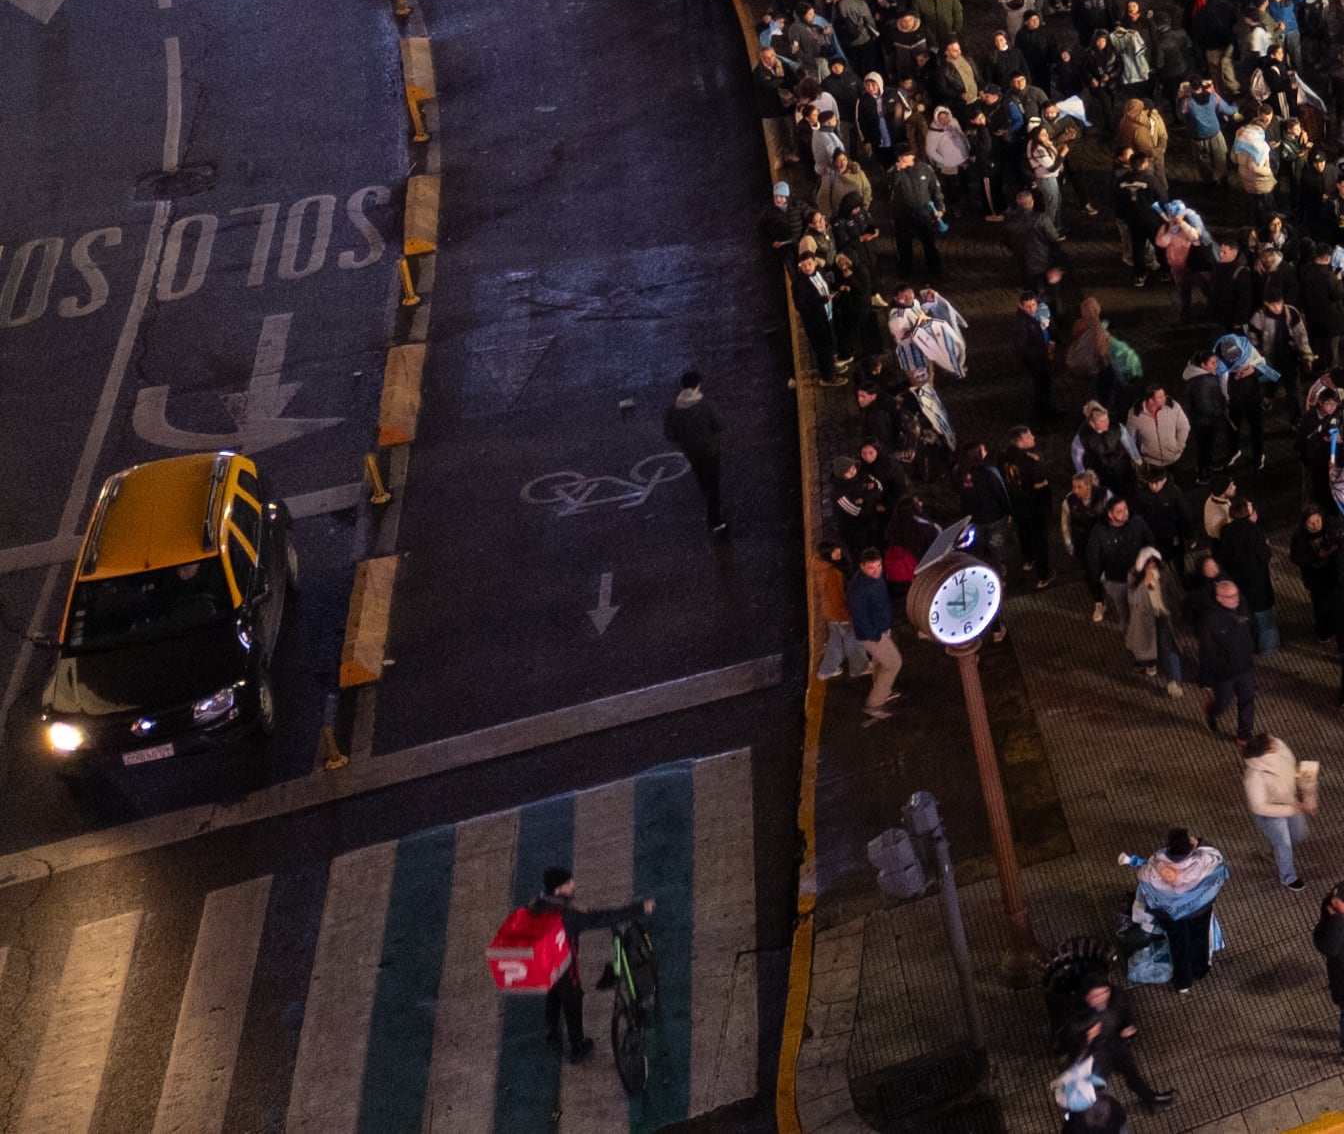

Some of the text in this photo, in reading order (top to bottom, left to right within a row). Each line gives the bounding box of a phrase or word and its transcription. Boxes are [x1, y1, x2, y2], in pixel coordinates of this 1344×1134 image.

[157, 185, 392, 301] SOLO
[0, 226, 122, 328] SO
[987, 581, 996, 594] 3
[930, 611, 940, 624] 9
[963, 621, 973, 634] 6
